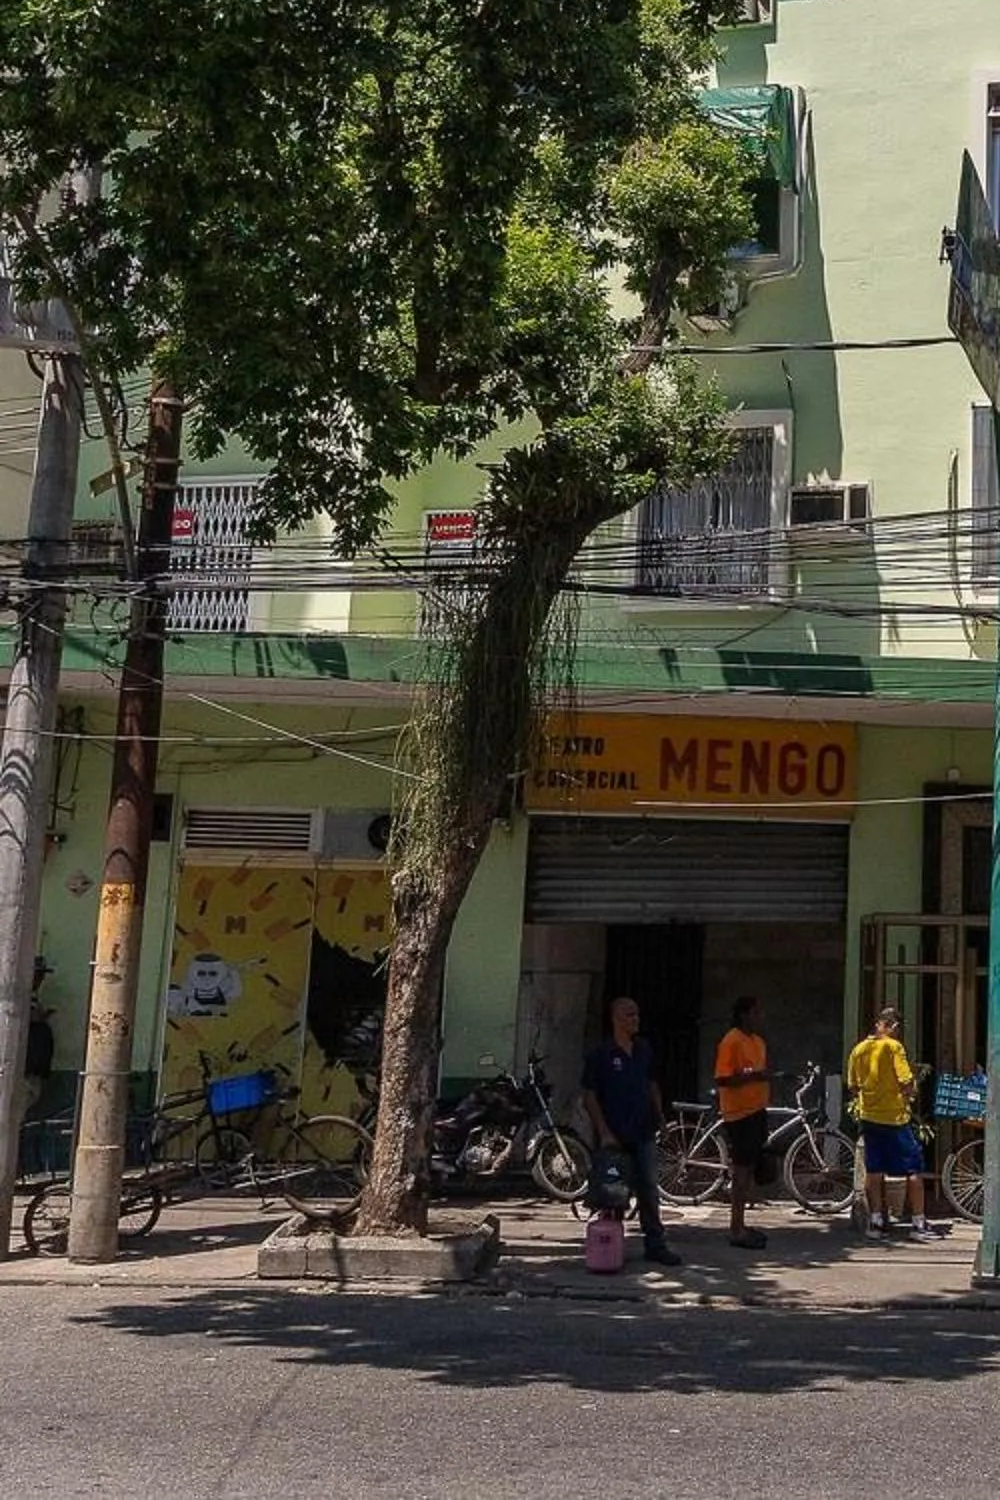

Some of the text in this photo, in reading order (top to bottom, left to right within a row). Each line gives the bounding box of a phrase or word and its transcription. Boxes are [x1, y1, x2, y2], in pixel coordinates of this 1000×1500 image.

[658, 736, 846, 797] MENGO
[224, 915, 247, 934] M
[364, 915, 385, 933] M
